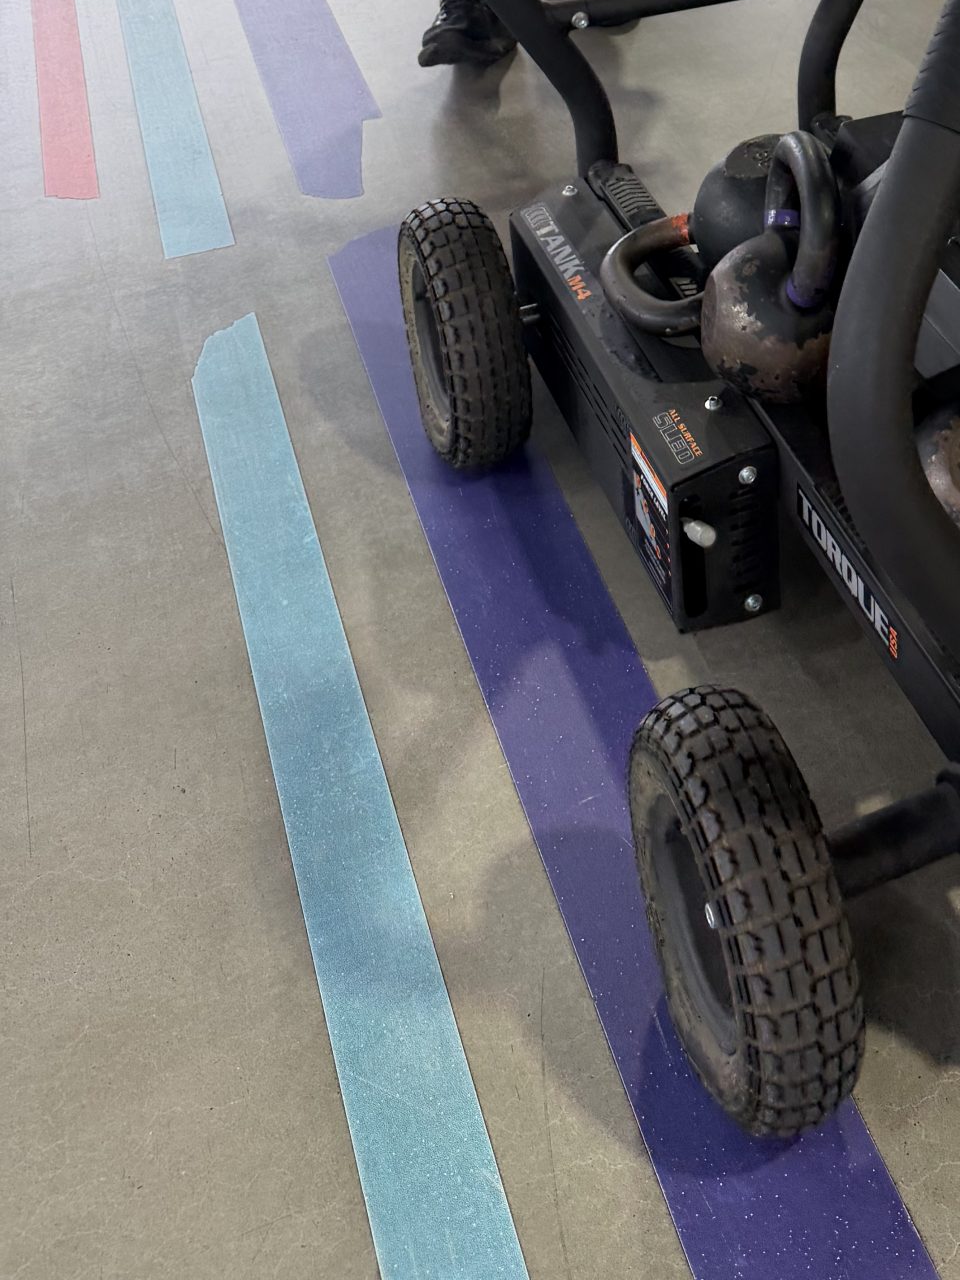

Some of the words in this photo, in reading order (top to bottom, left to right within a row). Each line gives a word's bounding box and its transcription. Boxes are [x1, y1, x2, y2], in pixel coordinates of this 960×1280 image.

[535, 220, 586, 279] TANK
[567, 274, 592, 301] M4
[652, 411, 695, 465] SLED
[668, 408, 681, 423] ALL
[677, 422, 703, 457] SURFACE
[798, 488, 889, 646] TORQUE
[888, 625, 899, 659] USA
